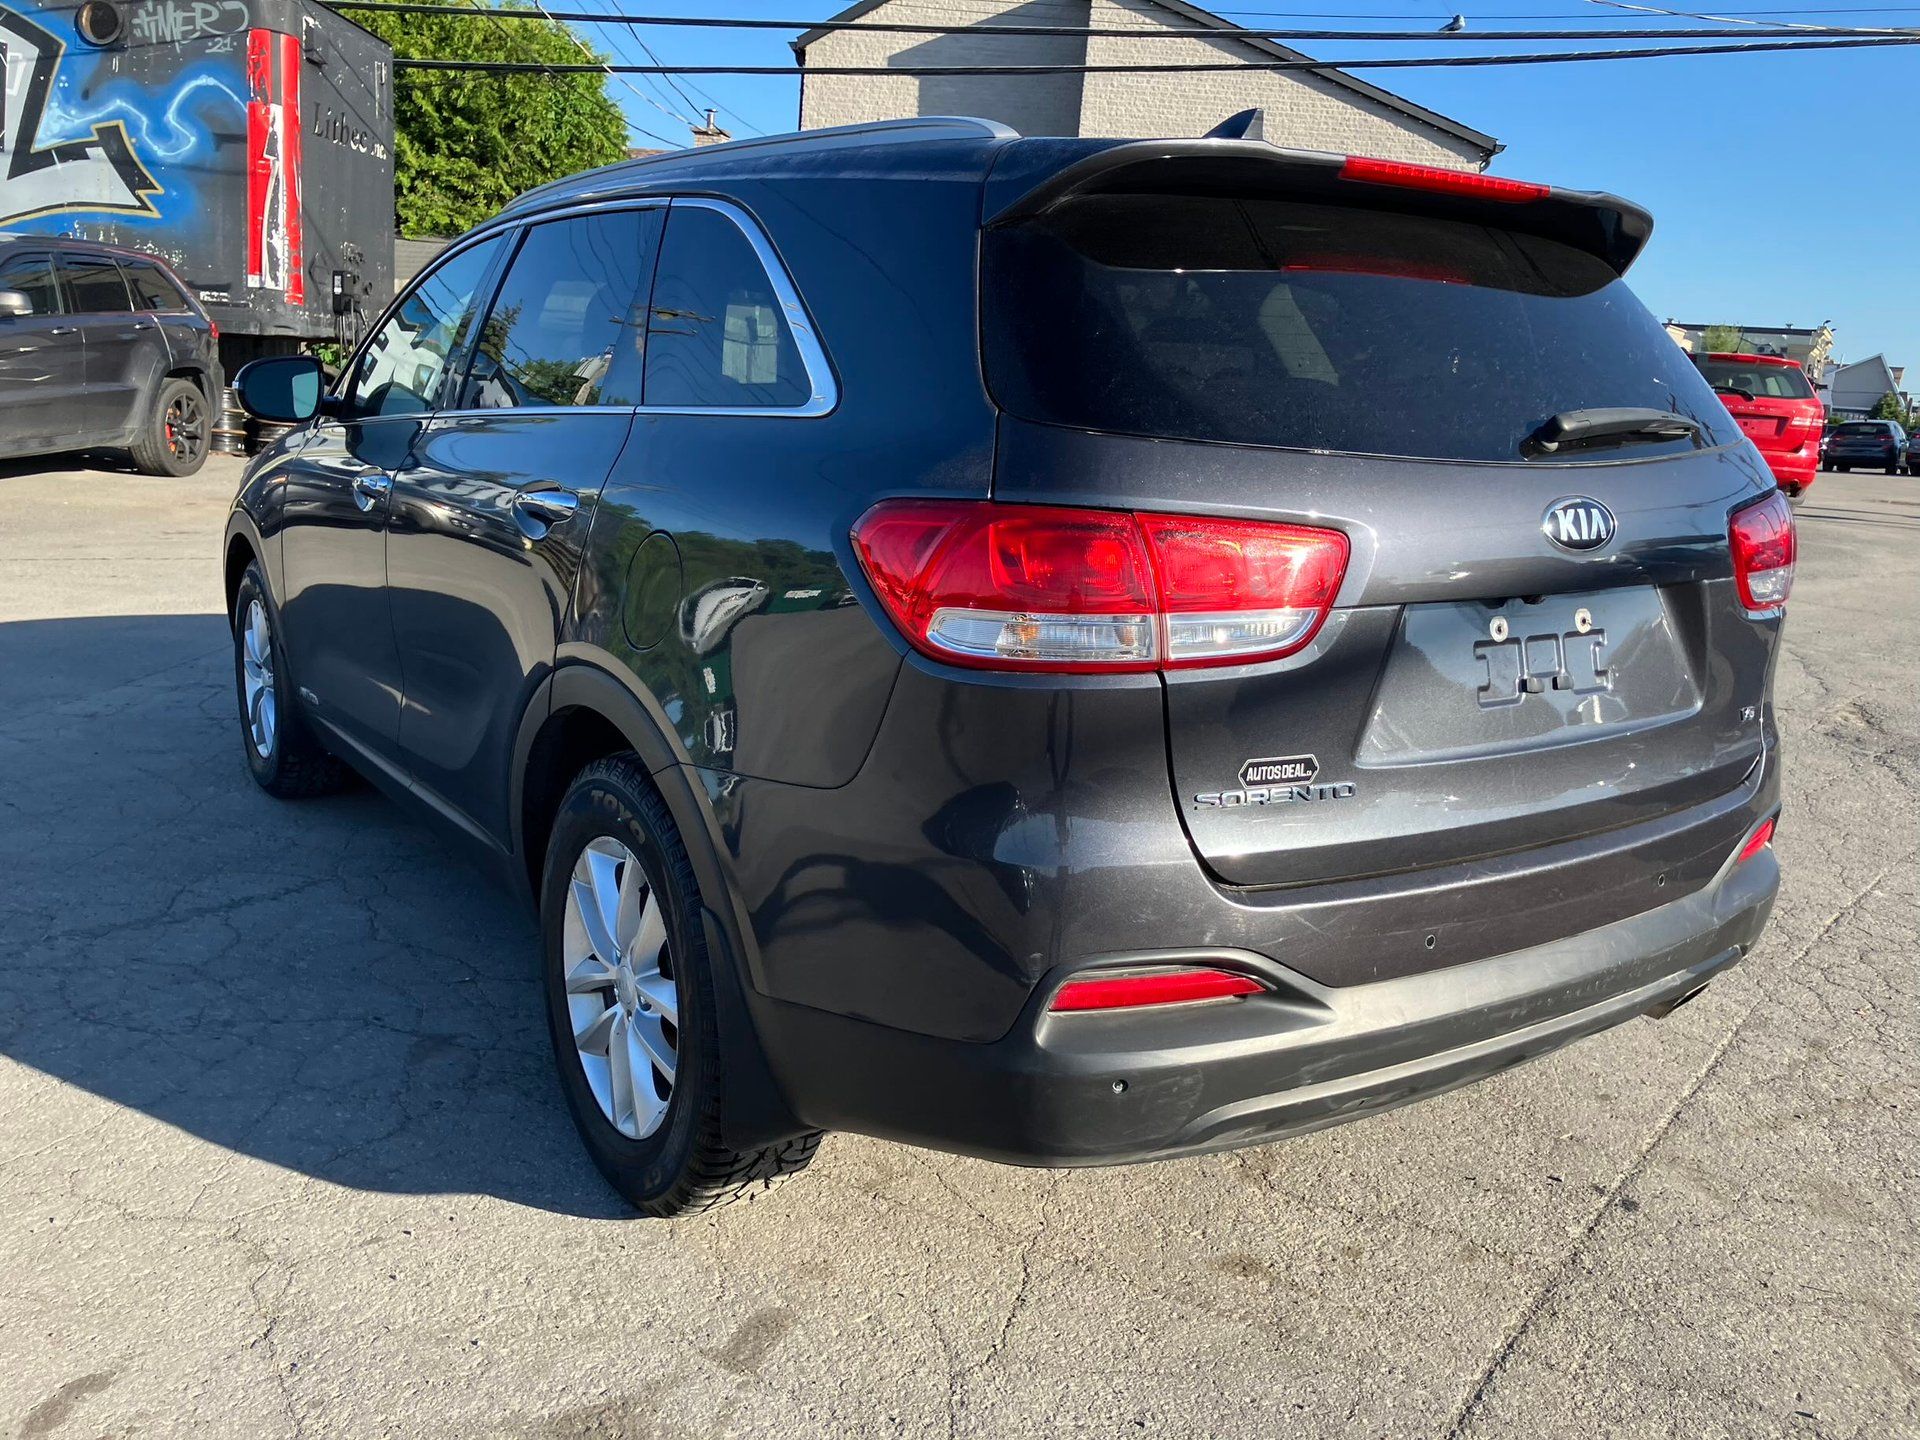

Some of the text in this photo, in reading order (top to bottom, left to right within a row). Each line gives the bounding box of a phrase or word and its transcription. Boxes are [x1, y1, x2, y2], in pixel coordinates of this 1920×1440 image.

[1555, 508, 1607, 541] KIA
[1194, 782, 1357, 809] SORENTO
[591, 789, 646, 845] TOYO
